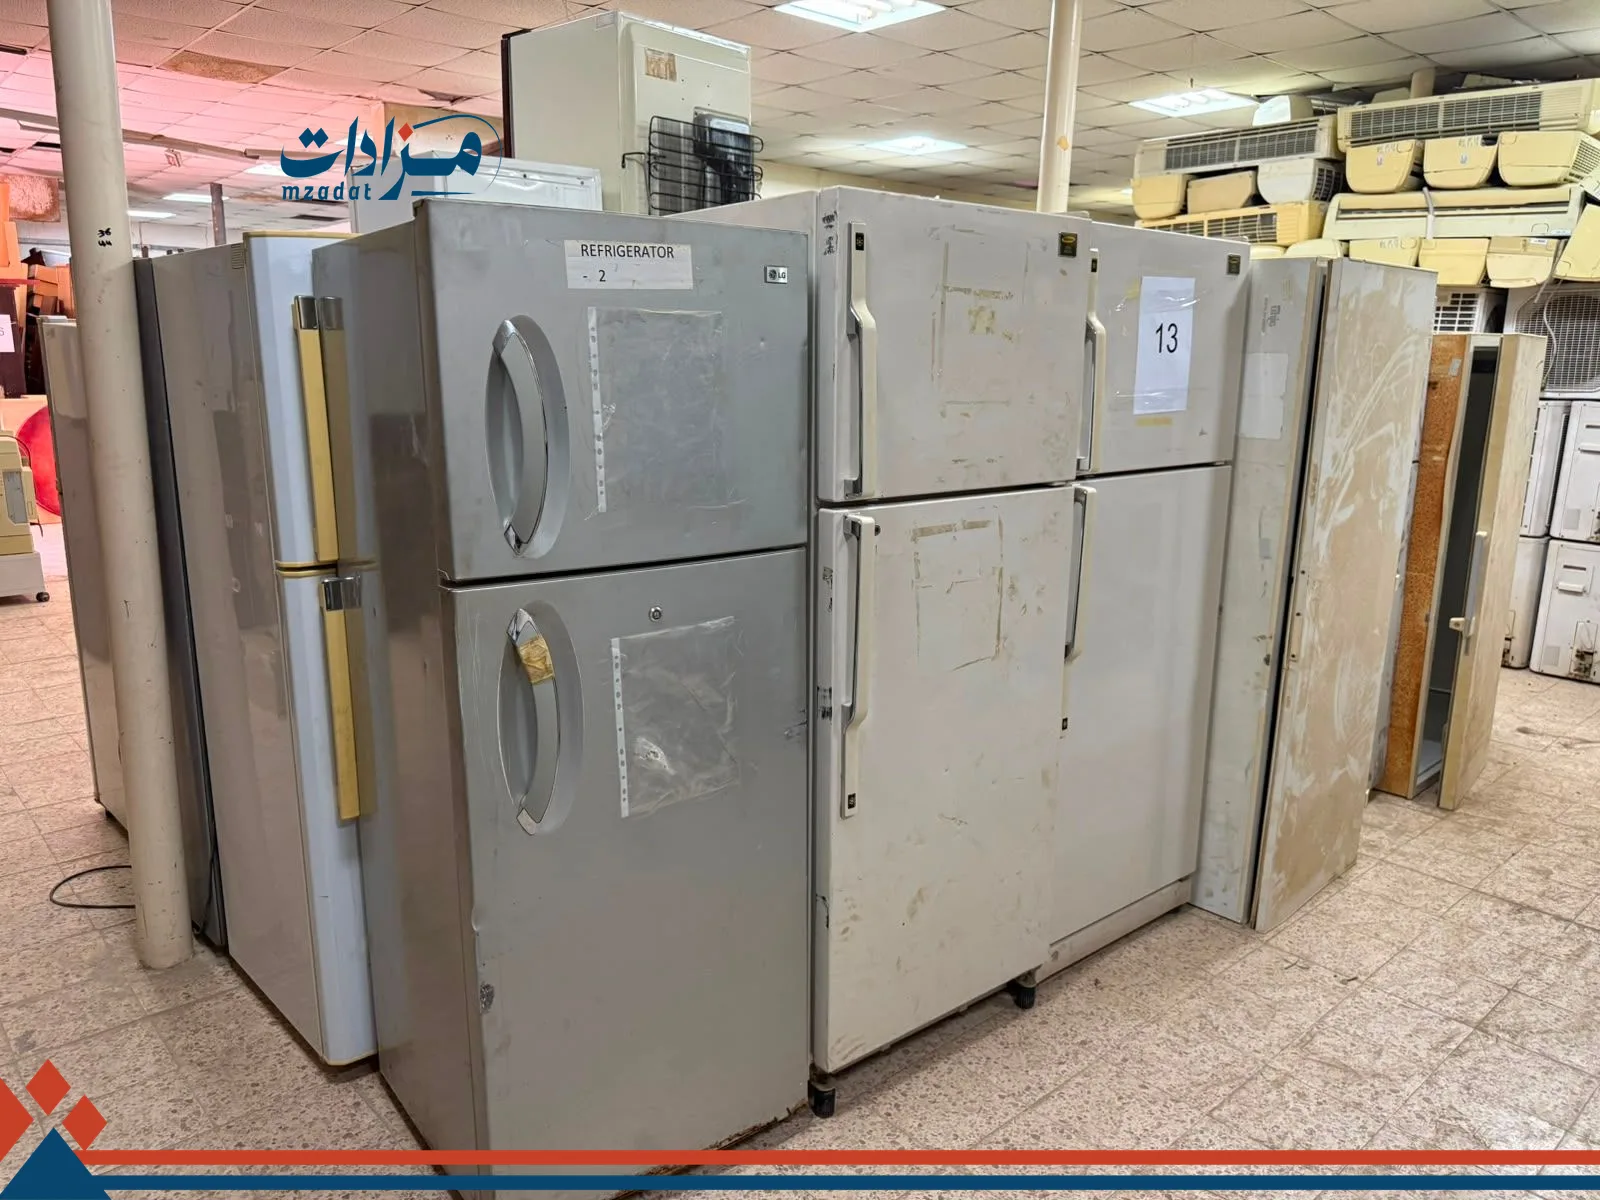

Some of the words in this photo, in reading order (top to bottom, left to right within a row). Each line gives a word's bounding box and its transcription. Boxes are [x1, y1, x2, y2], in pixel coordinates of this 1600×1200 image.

[580, 243, 675, 259] REFRIGERATOR
[598, 269, 606, 282] 2
[777, 271, 786, 279] LG
[1155, 322, 1178, 353] 13
